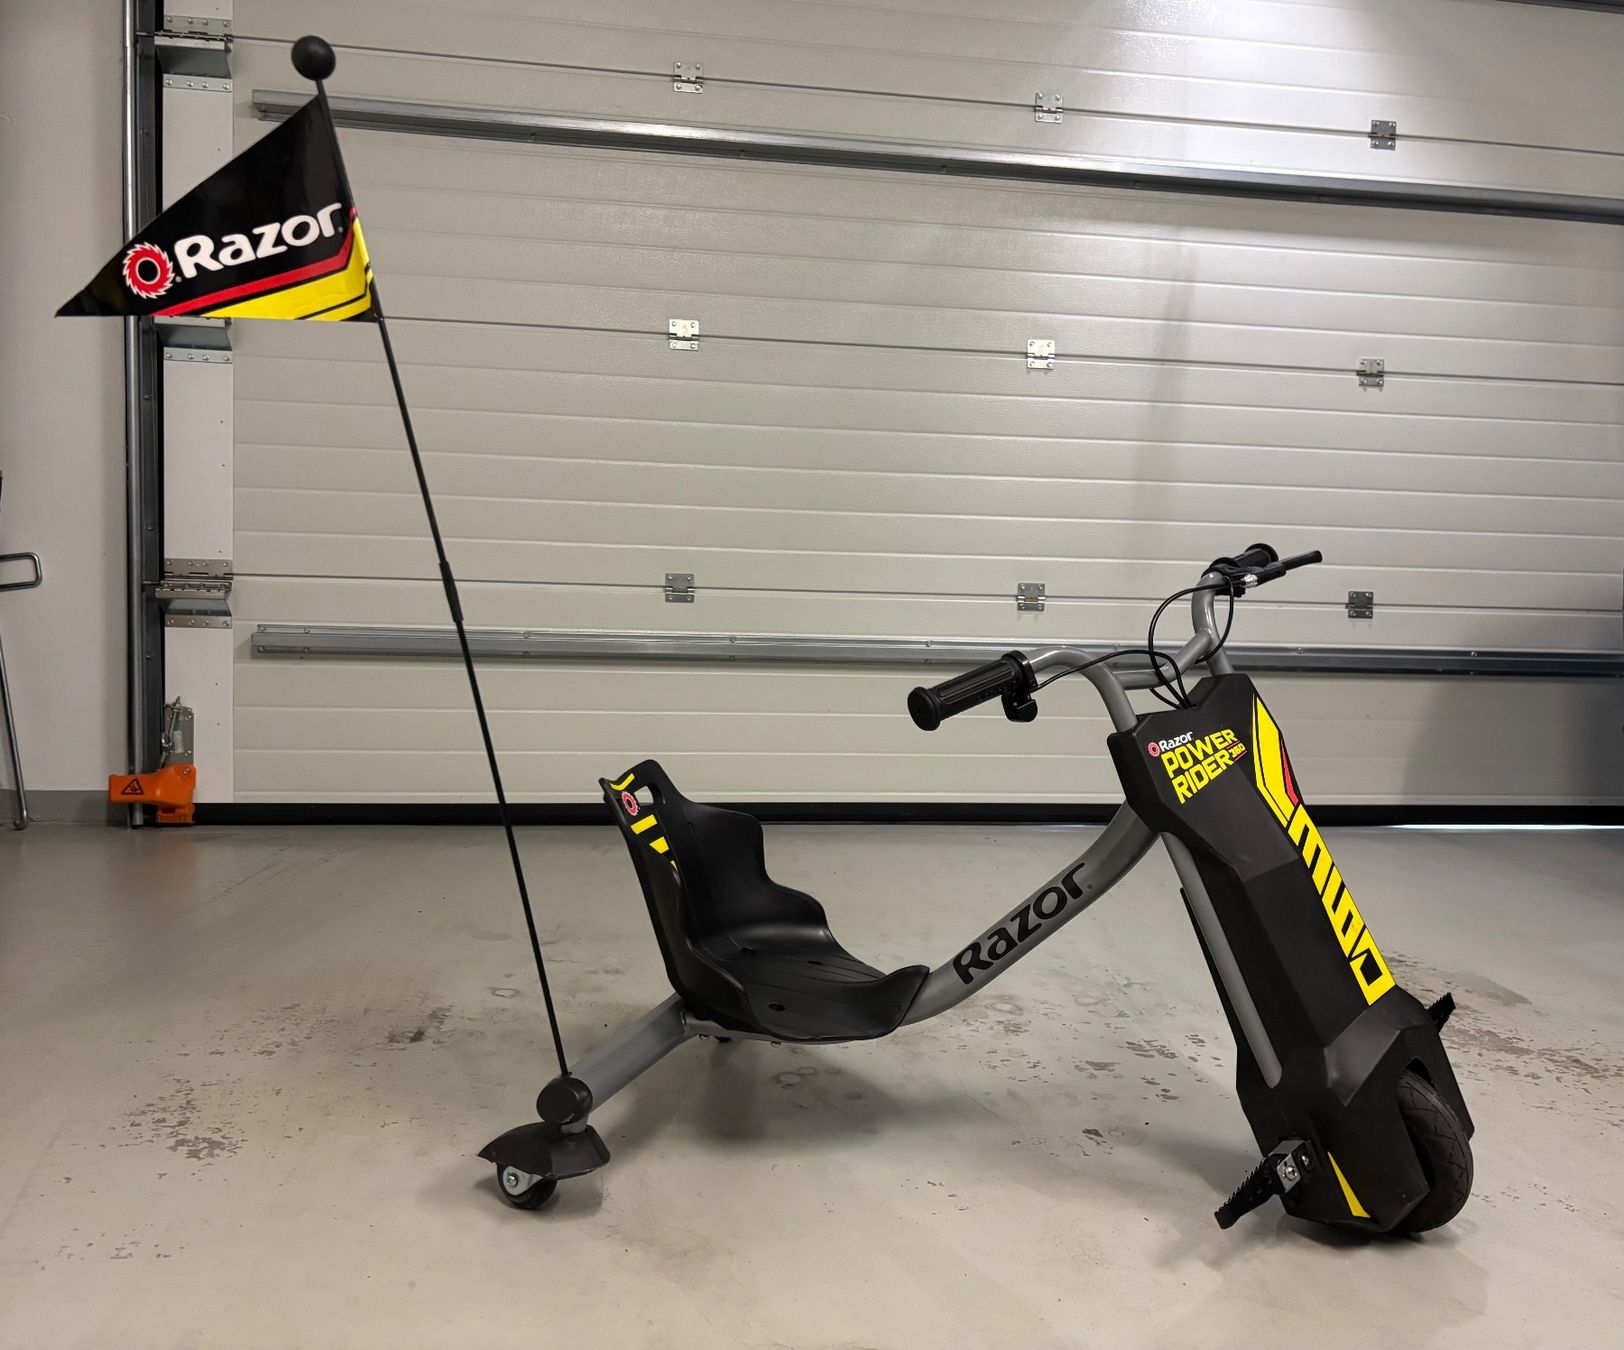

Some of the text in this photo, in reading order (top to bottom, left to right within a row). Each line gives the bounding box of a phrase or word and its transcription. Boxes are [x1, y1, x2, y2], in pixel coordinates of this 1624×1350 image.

[174, 202, 342, 279] Razor
[1158, 731, 1193, 752] Razor
[1160, 729, 1238, 779] POWER
[1171, 749, 1234, 804] RIDER
[952, 862, 1085, 985] Razor
